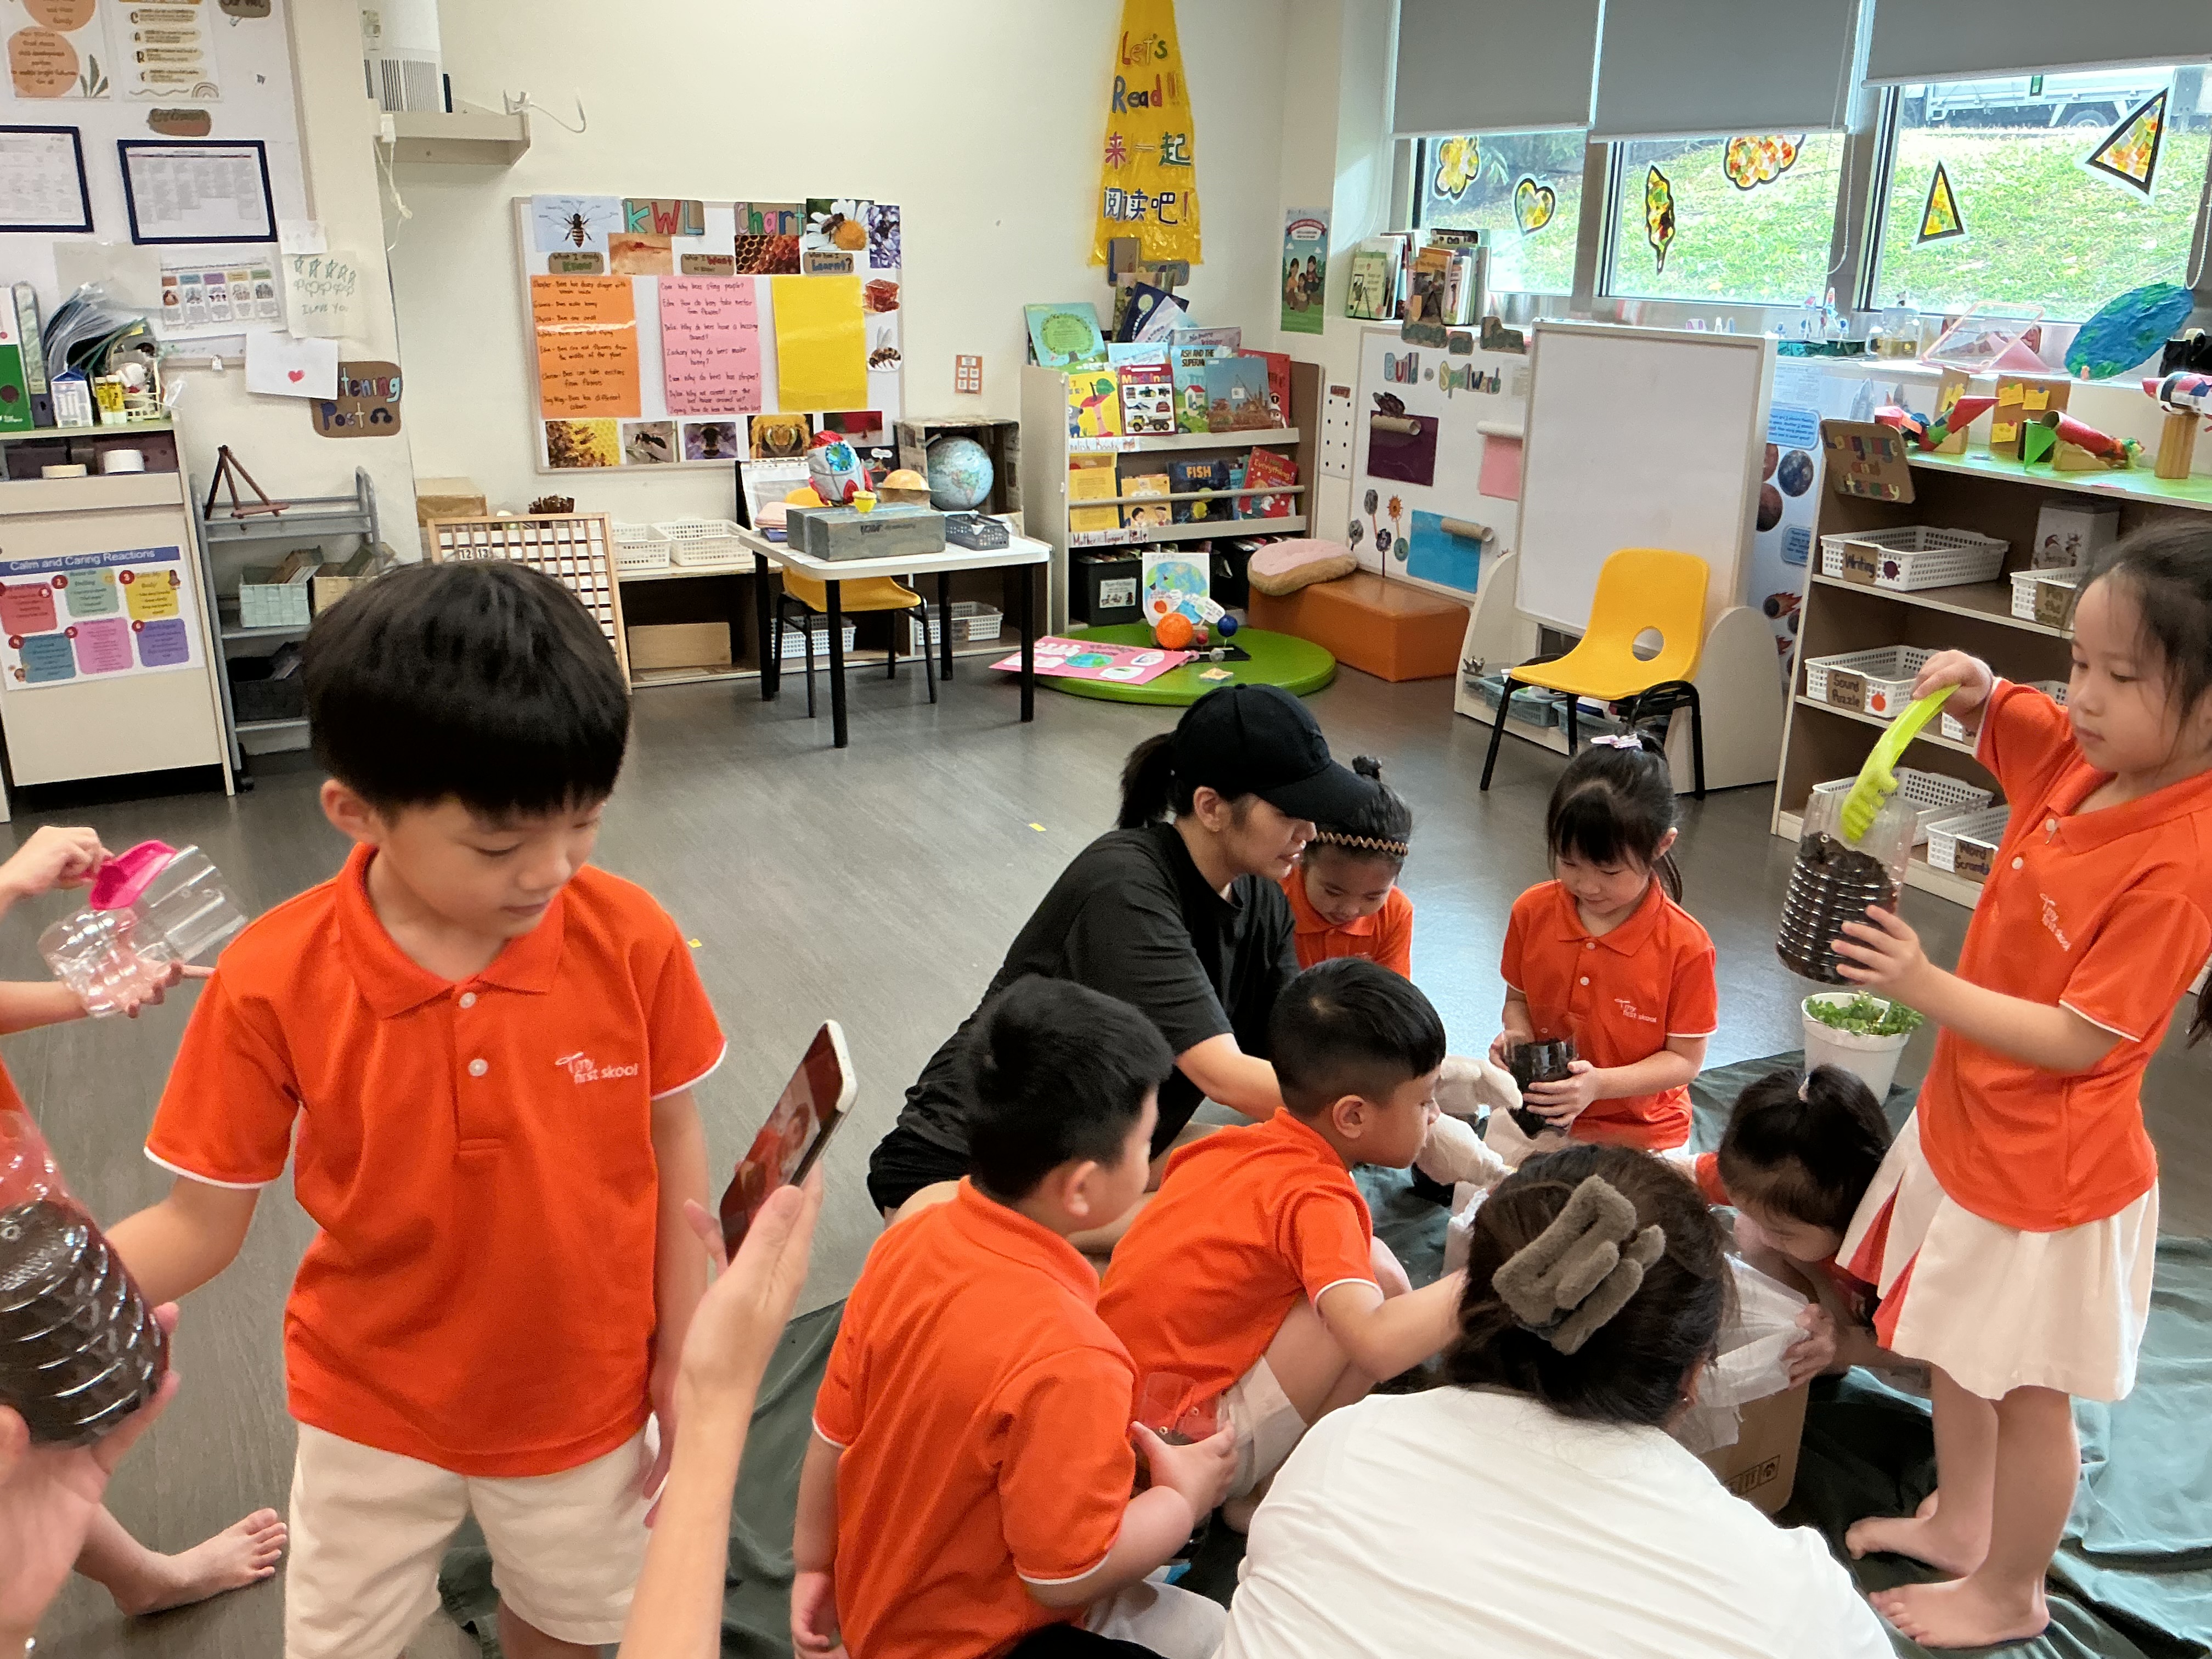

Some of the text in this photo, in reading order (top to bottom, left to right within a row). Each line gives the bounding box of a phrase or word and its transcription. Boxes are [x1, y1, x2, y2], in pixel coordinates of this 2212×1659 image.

[1122, 31, 1169, 65] Let's
[735, 202, 805, 235] Chart
[1193, 349, 1204, 357] AND
[1205, 348, 1215, 357] THE
[338, 367, 401, 402] tening
[320, 402, 364, 430] Post
[1070, 438, 1091, 451] nglish
[1186, 466, 1211, 478] FISH
[10, 549, 155, 571] Calm and Caring Reactions
[460, 549, 472, 558] 12
[478, 548, 488, 558] 13
[1845, 553, 1876, 578] Writing
[1833, 673, 1859, 692] Sound
[1832, 689, 1860, 707] Puzzle
[1959, 842, 1987, 860] Word
[1955, 855, 1990, 875] Scramb
